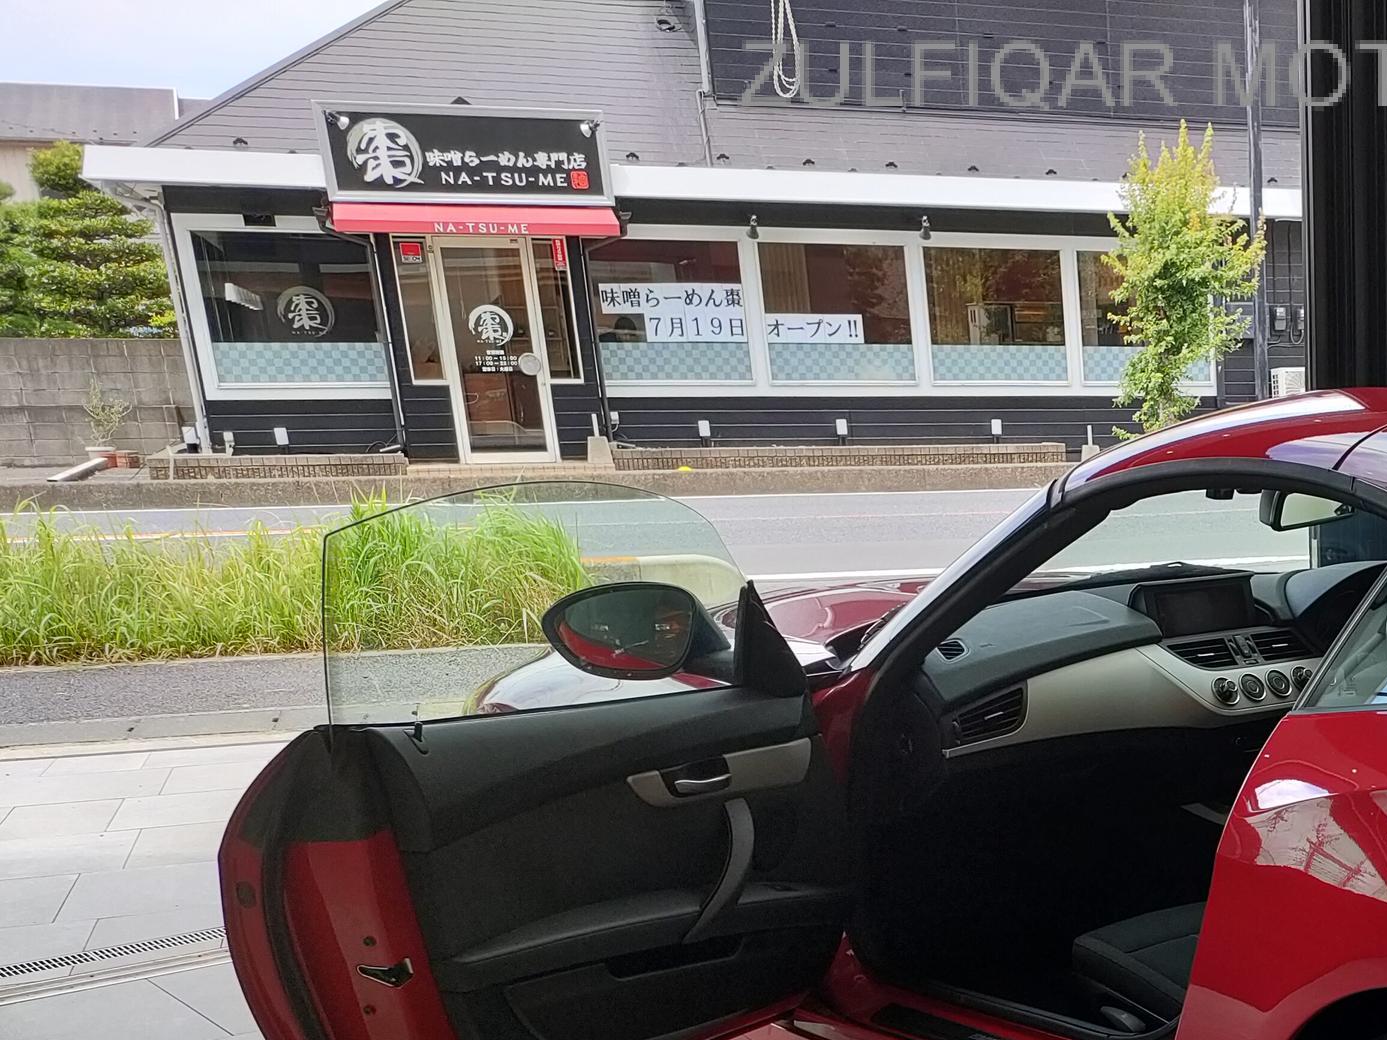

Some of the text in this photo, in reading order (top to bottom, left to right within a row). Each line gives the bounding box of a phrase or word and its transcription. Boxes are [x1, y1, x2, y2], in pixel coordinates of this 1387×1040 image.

[425, 149, 587, 169] 味噌らーめん専門店
[441, 171, 568, 187] NA-TSU-ME
[434, 222, 529, 234] NA-TSU-ME
